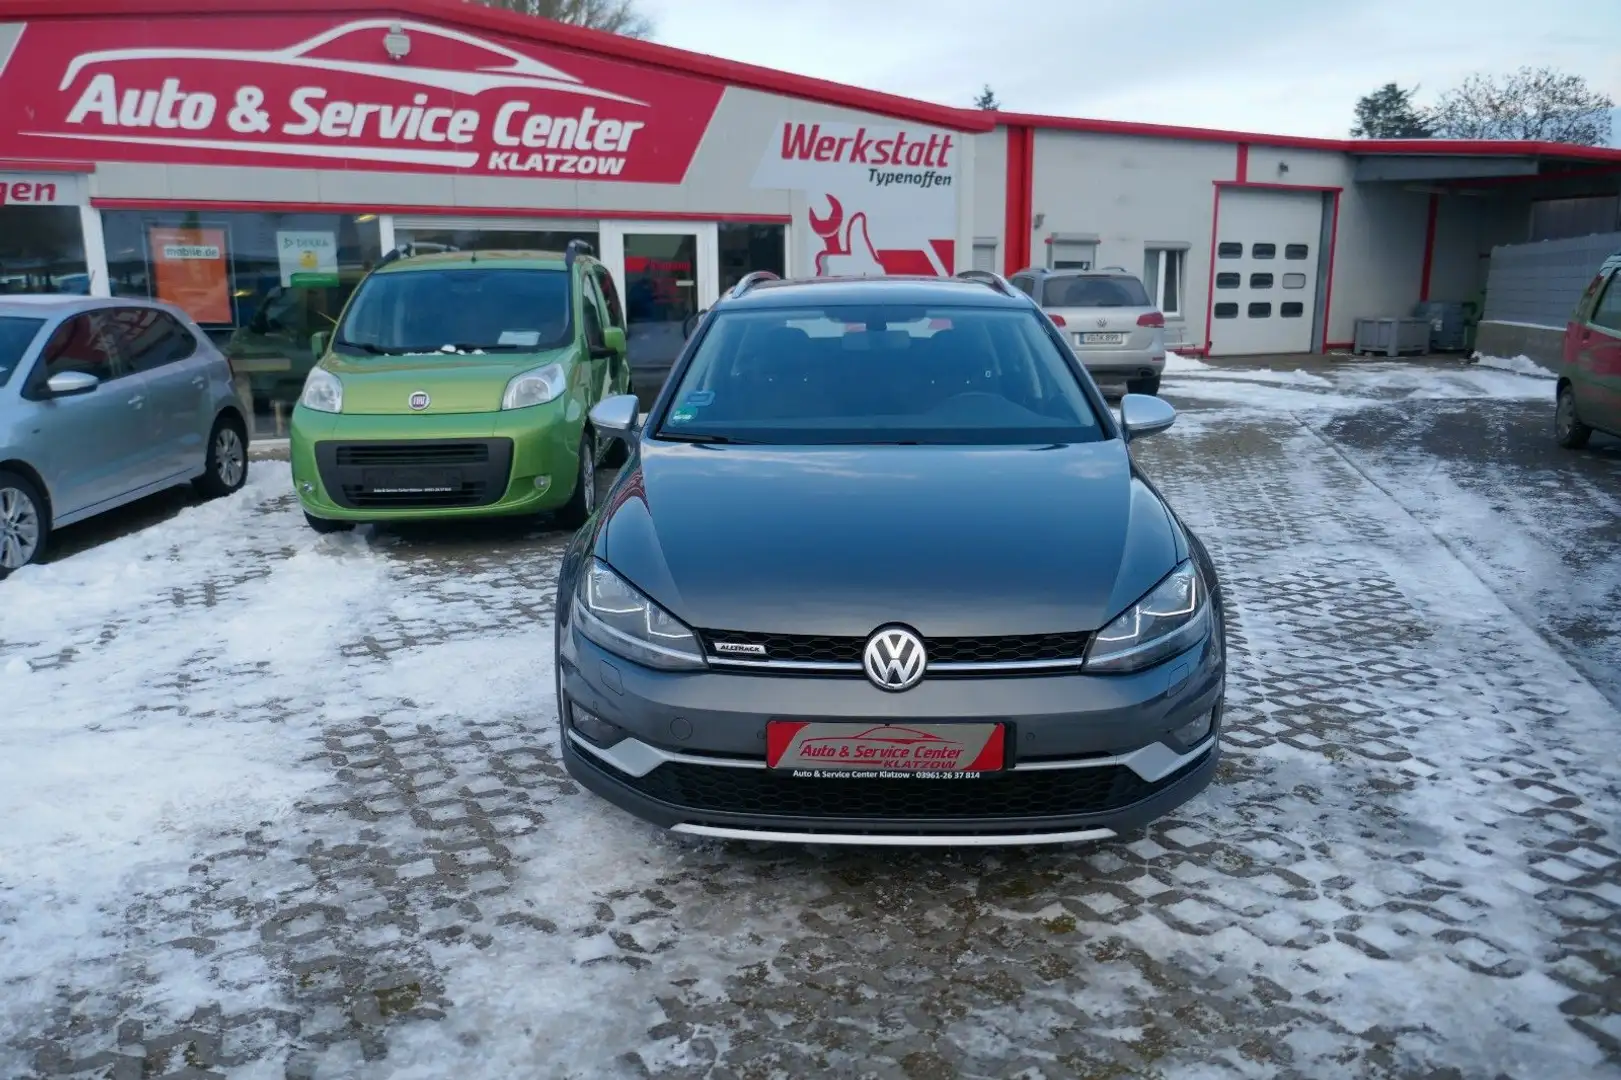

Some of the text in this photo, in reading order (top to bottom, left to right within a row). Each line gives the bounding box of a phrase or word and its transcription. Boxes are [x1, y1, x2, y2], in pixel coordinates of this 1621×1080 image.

[65, 74, 645, 152] Auto & Service Center
[781, 122, 954, 168] Werkstatt
[488, 152, 626, 175] KLATZOW
[868, 168, 952, 188] Typenoffen
[166, 247, 218, 257] mobile.de
[800, 744, 964, 759] Auto & Service Center
[884, 760, 957, 769] KLATZOW
[793, 769, 812, 778] Auto
[813, 770, 821, 778] &
[822, 770, 850, 778] Service
[852, 770, 878, 779] Center
[879, 771, 910, 779] Klatzow
